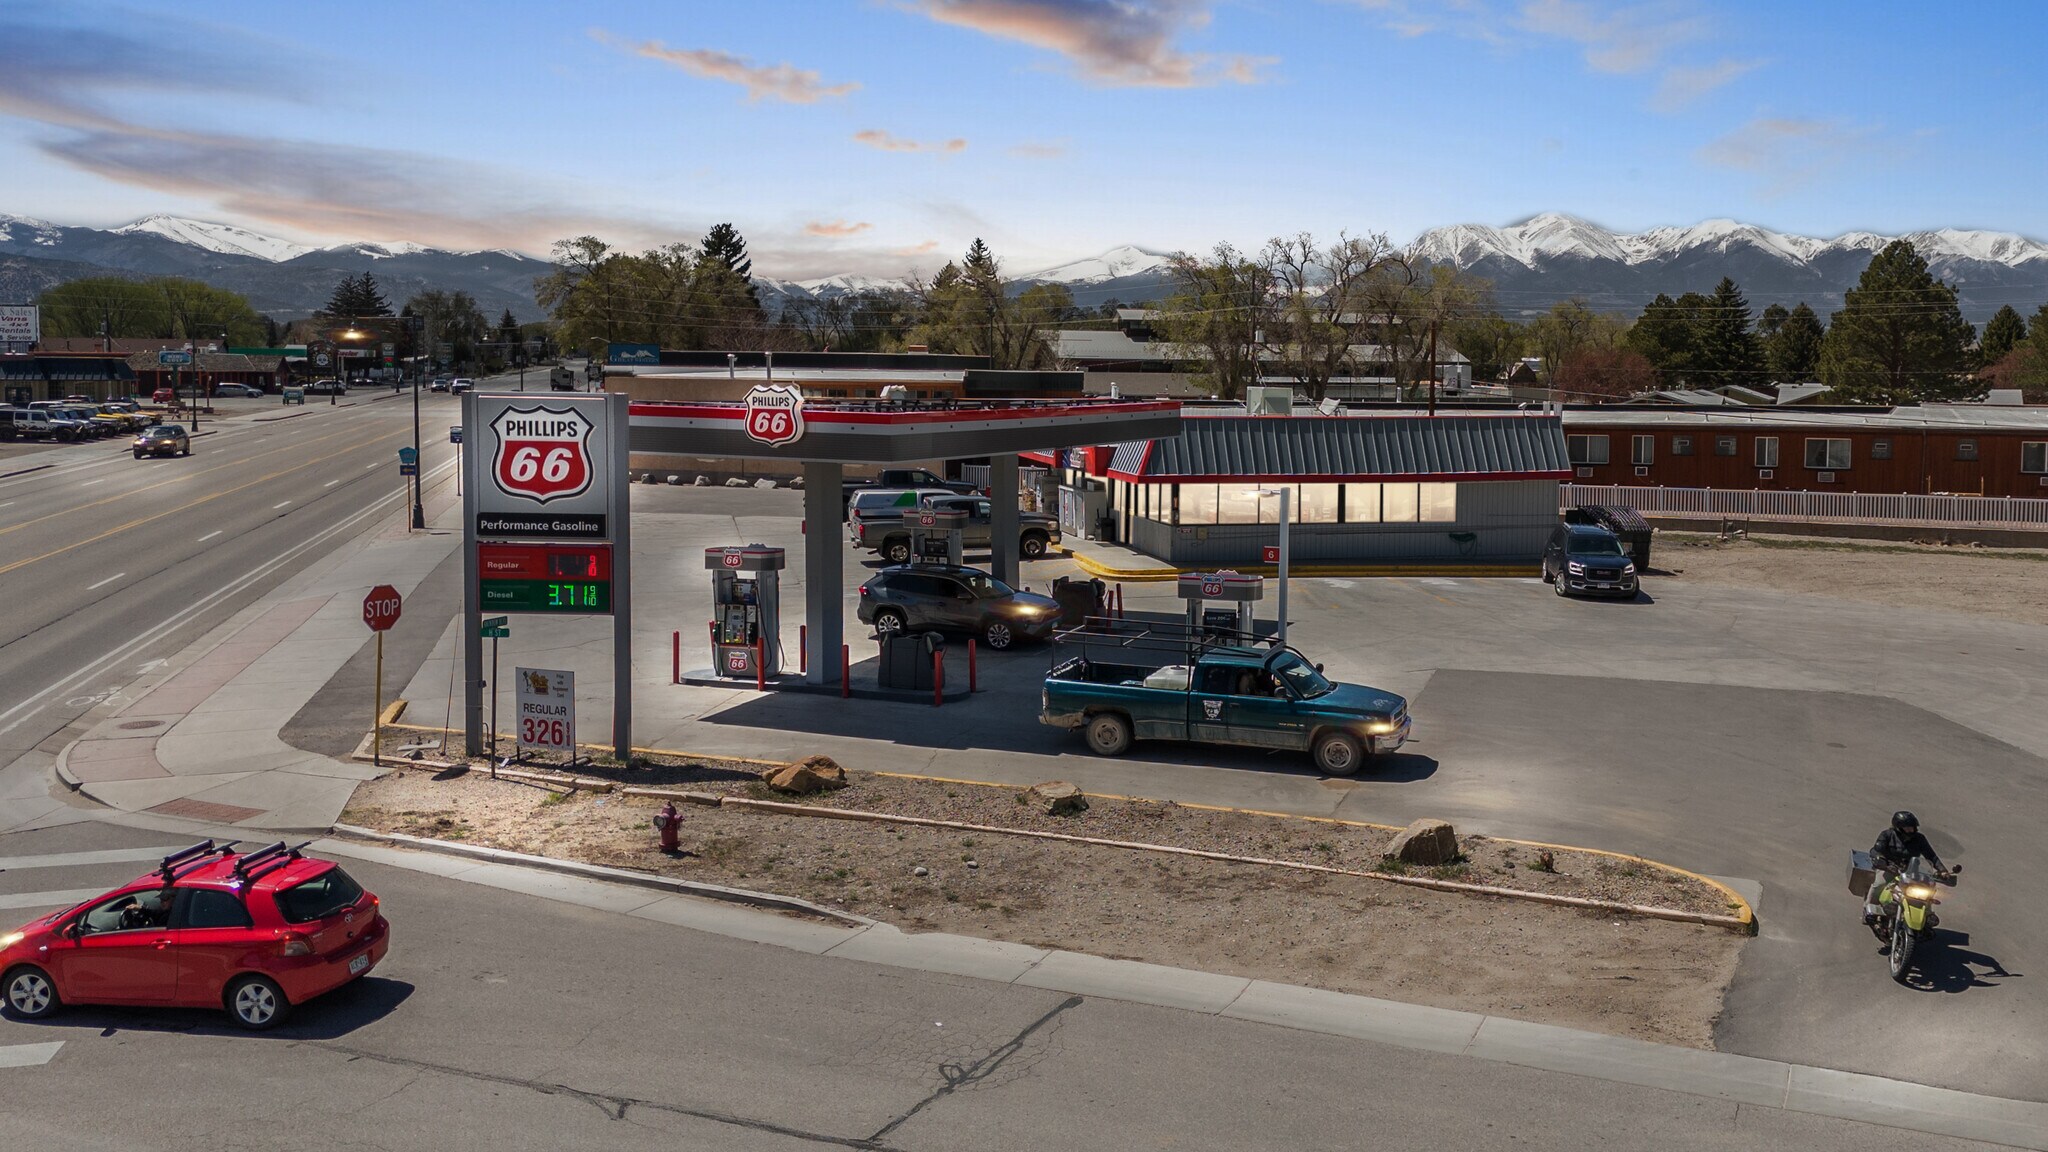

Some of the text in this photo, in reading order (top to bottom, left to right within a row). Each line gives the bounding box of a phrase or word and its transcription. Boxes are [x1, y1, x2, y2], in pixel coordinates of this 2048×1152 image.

[10, 307, 32, 316] Sales
[752, 396, 790, 407] PHILLIPS
[754, 412, 787, 433] 66
[506, 420, 578, 437] PHILLIPS
[510, 446, 573, 482] 66
[480, 520, 598, 531] Performance Gasoline
[726, 556, 739, 564] 66
[1268, 550, 1275, 559] 6
[487, 561, 519, 570] Regular
[1205, 584, 1219, 593] 66
[365, 598, 400, 618] STOP
[731, 659, 744, 668] 66
[523, 703, 567, 716] REGULAR
